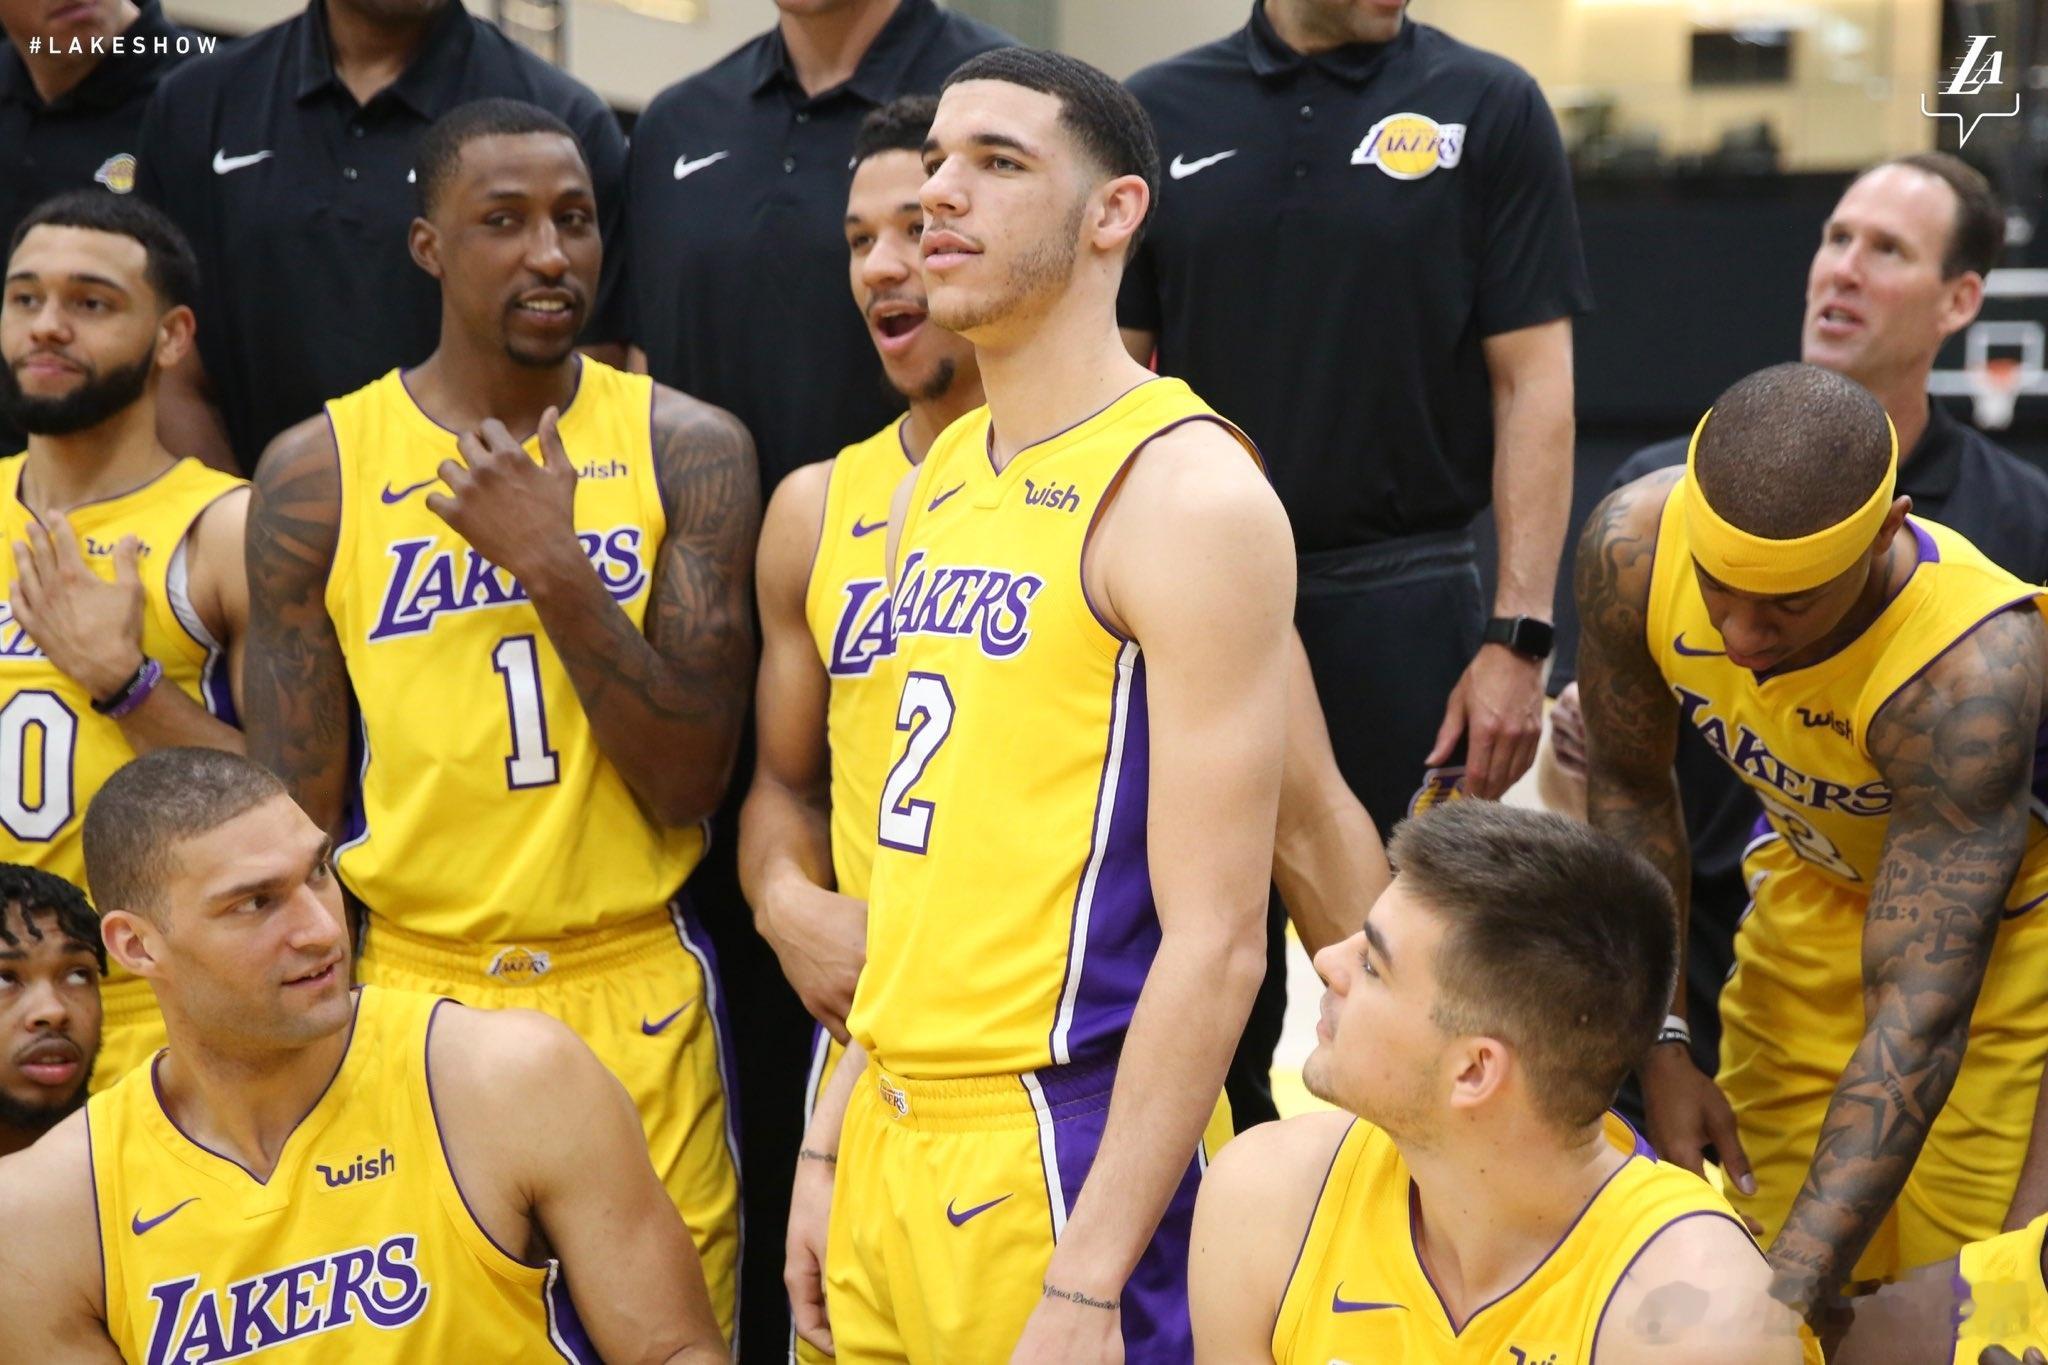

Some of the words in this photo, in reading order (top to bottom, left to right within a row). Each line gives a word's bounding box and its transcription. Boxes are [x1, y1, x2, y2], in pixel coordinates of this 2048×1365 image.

[1024, 478, 1081, 513] wish
[891, 549, 1047, 661] LAKERS
[0, 690, 78, 842] 0
[492, 634, 561, 790] 1
[878, 671, 957, 855] 2
[316, 1148, 395, 1188] wish
[147, 1233, 431, 1365] LAKERS
